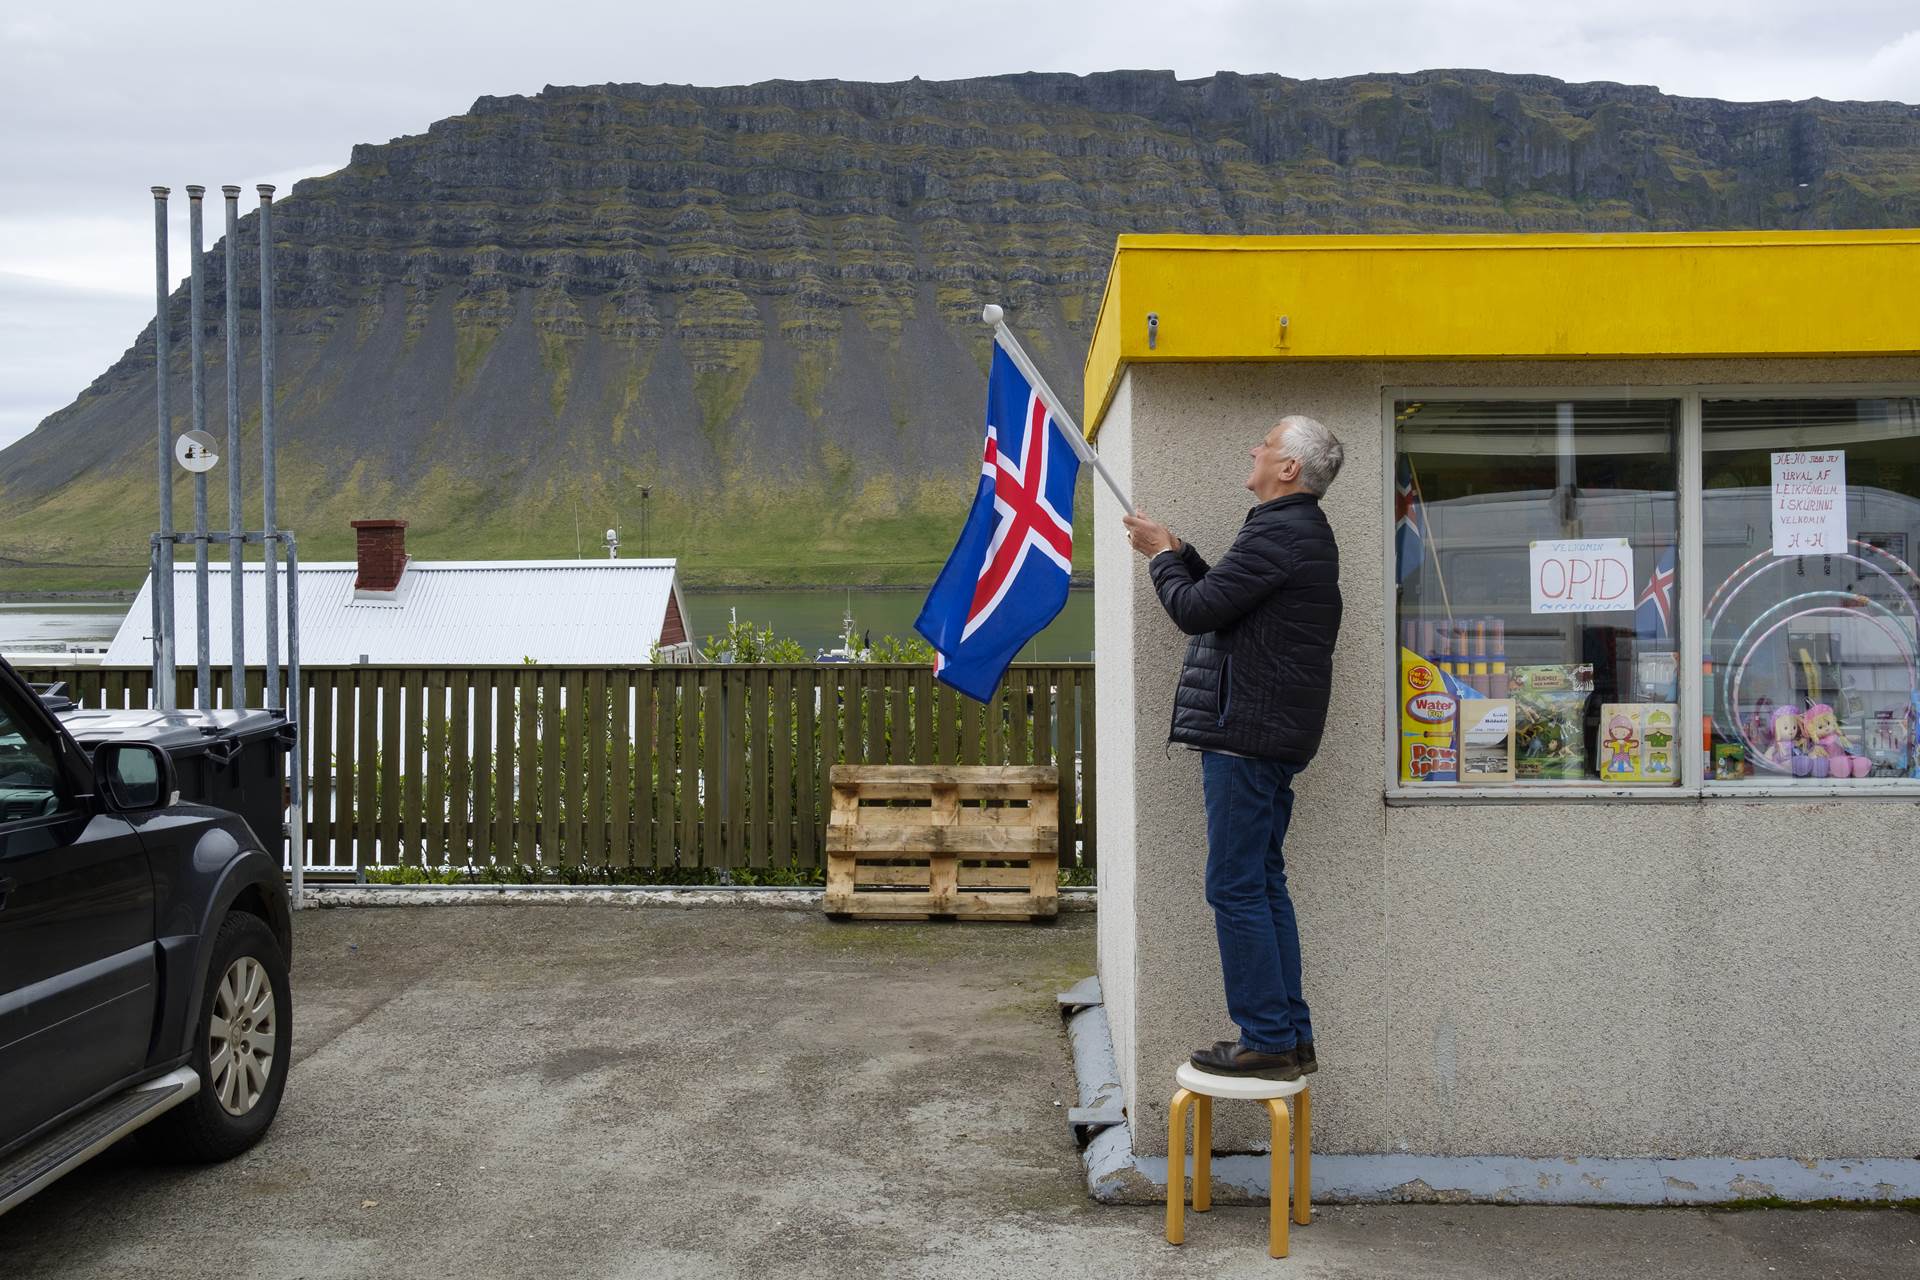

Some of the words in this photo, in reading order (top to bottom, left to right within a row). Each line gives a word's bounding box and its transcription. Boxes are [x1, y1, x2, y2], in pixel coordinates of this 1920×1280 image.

[1816, 469, 1831, 480] AF
[1780, 515, 1826, 524] VELKOMIN
[1552, 543, 1604, 552] VELKOMIN
[1416, 699, 1454, 711] Water
